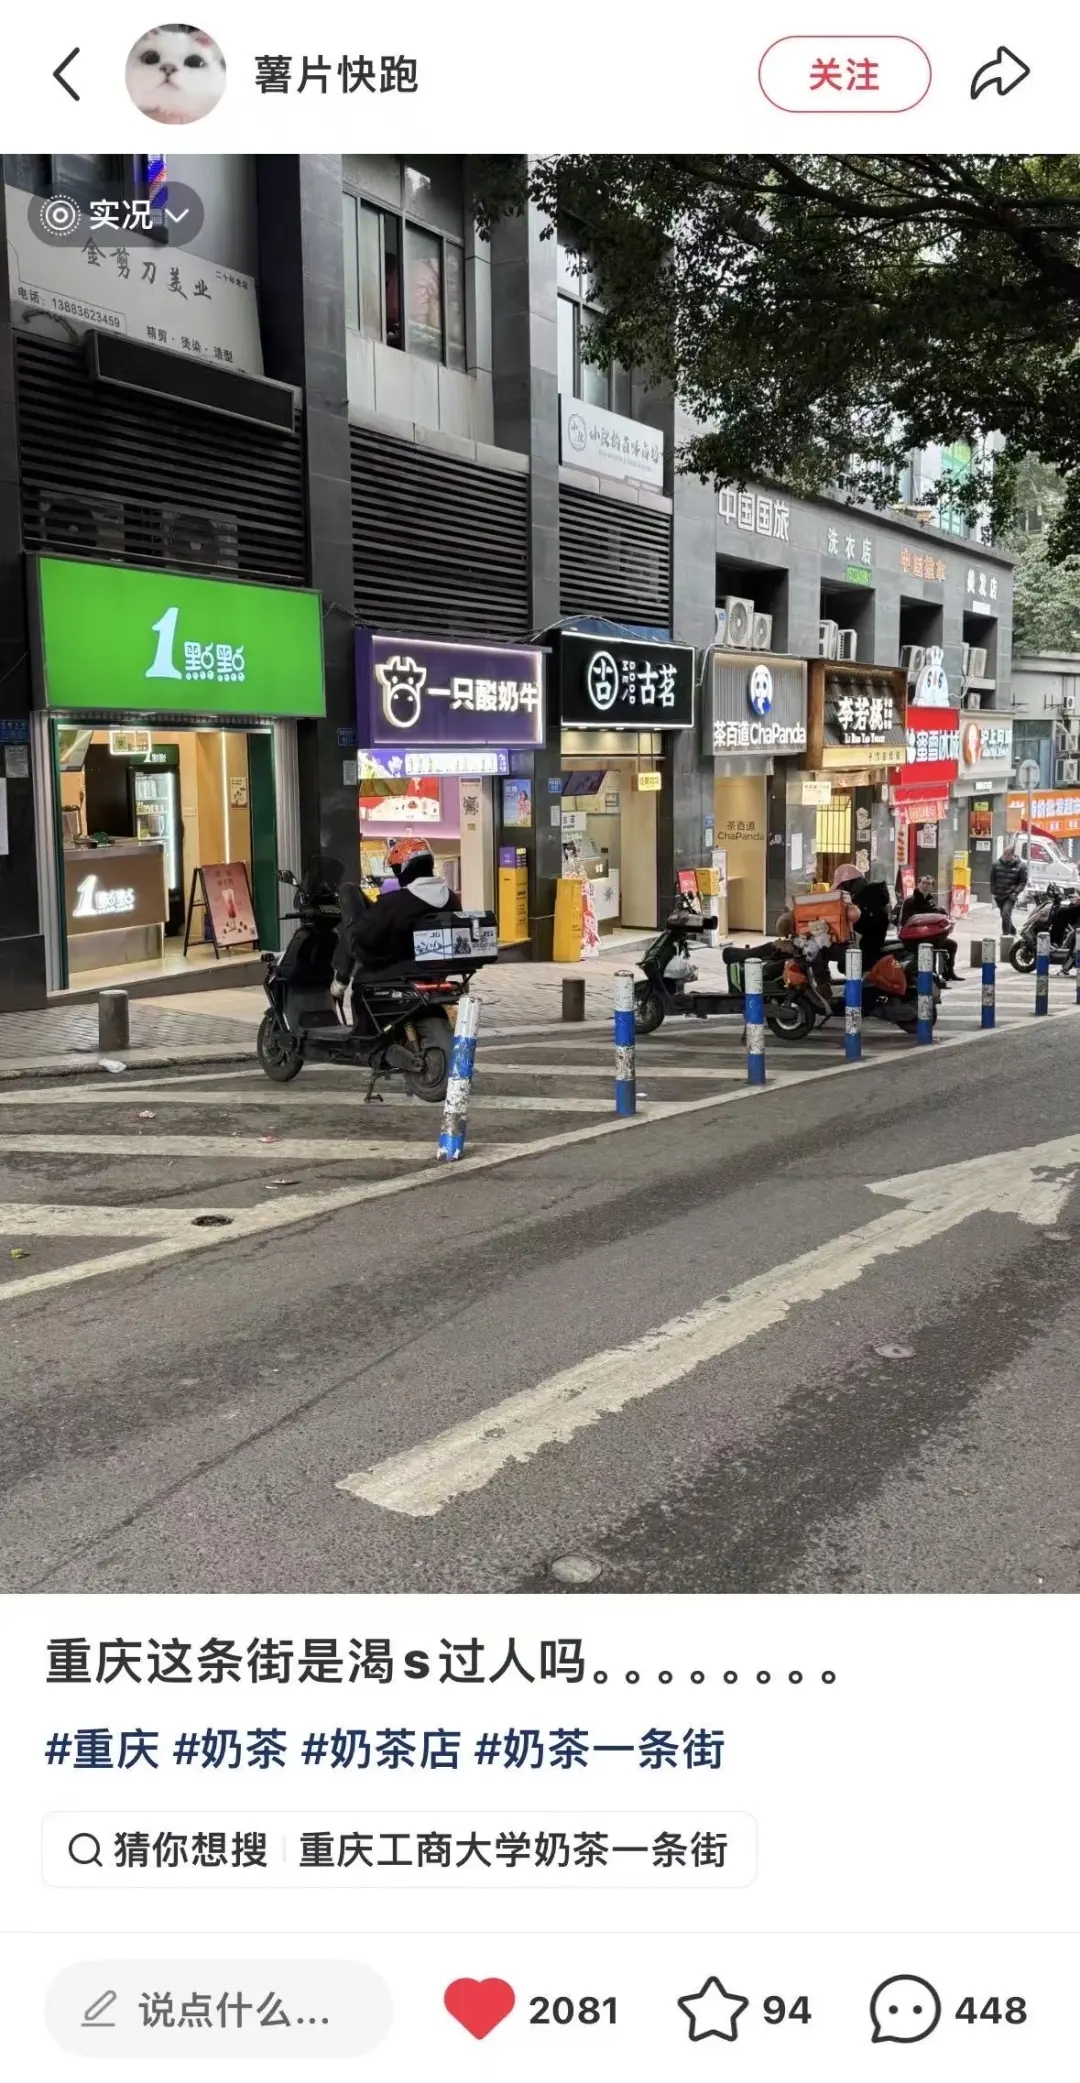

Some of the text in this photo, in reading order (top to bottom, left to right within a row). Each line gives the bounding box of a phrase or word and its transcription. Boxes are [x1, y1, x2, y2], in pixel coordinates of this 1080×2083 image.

[81, 236, 212, 300] 金剪刀美业
[51, 297, 121, 328] 13883623459
[719, 486, 789, 541] 中国国旅
[827, 528, 872, 566] 洗衣店
[427, 677, 541, 713] 一只酸奶牛
[637, 660, 678, 708] 古茗
[916, 729, 960, 762] 蜜雪冰城
[717, 831, 765, 841] ChaPanda
[726, 821, 756, 831] 茶百道
